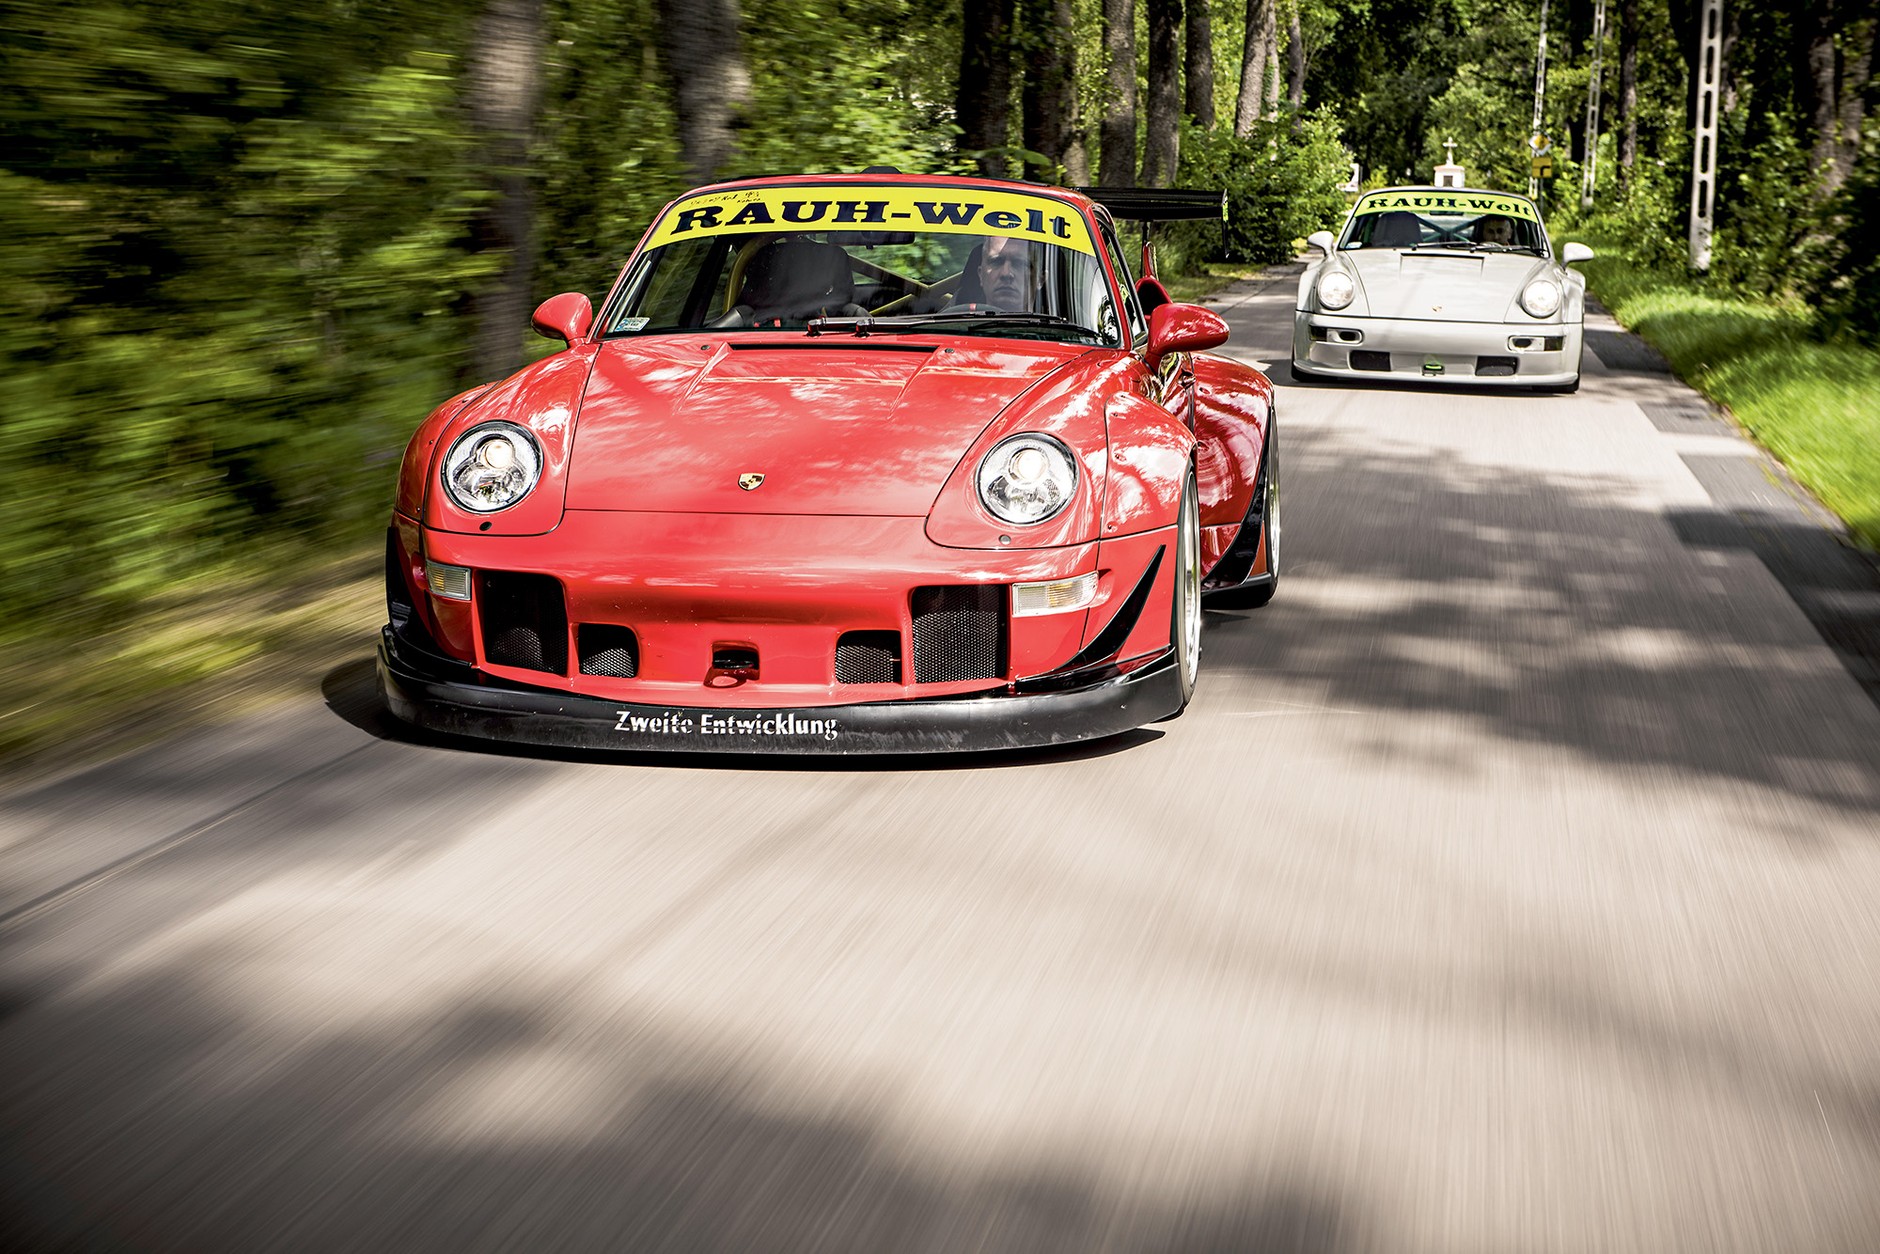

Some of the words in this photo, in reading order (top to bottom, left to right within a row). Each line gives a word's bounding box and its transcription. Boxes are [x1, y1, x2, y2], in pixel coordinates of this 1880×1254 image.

[670, 201, 1071, 239] RAUH-Welt
[1368, 198, 1532, 216] RAUH-Welt
[614, 710, 693, 734] Zweite
[700, 712, 838, 741] Entwicklung
